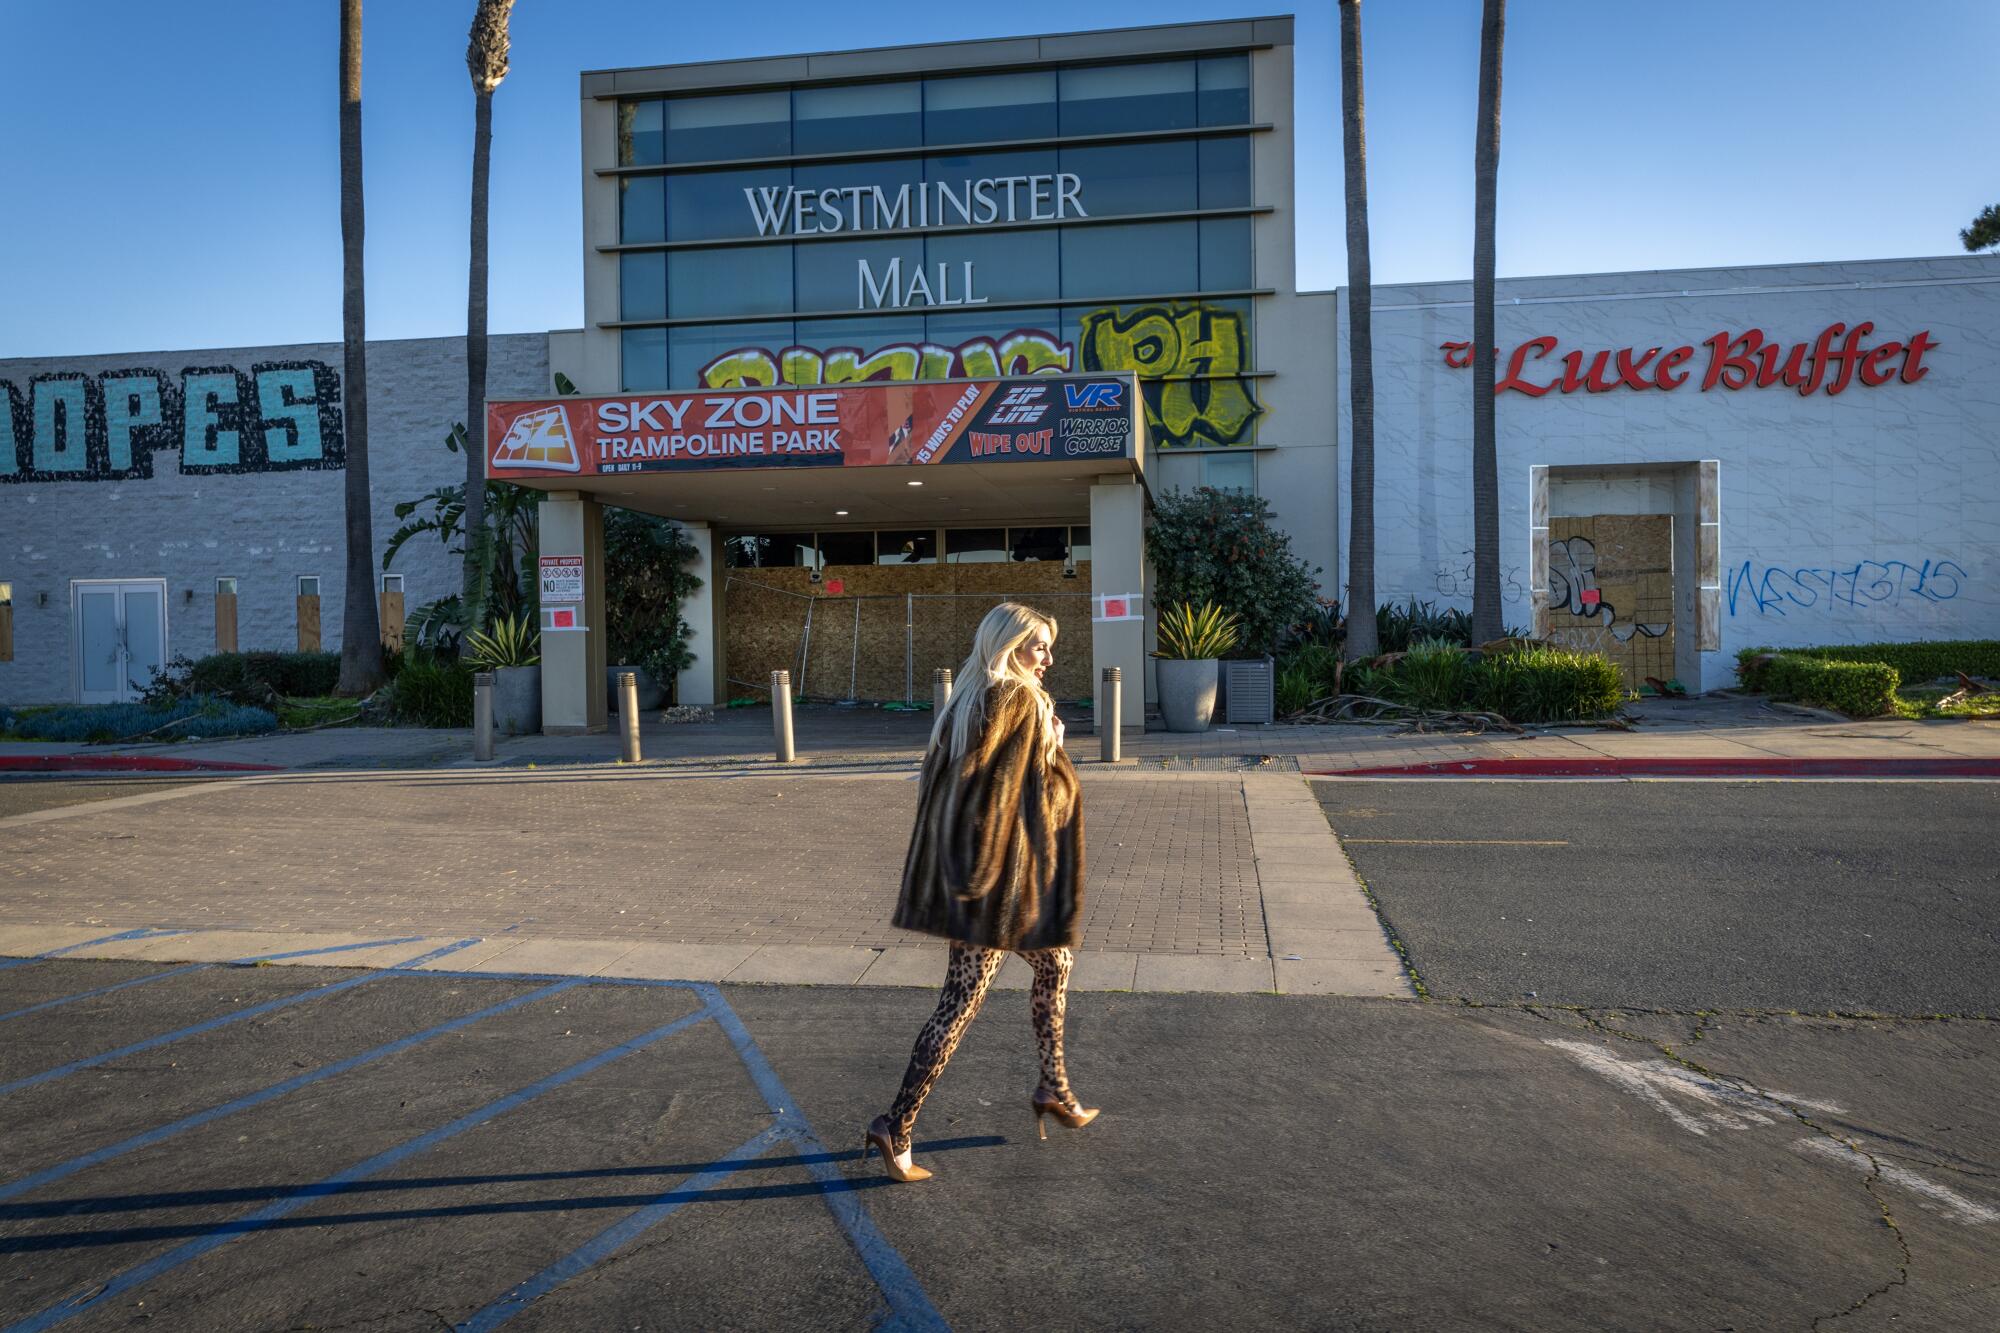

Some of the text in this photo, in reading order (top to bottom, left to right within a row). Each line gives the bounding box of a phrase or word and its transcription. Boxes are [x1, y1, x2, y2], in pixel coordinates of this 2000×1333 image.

[744, 172, 1089, 237] WESTMINSTER
[857, 256, 989, 310] MALL
[1493, 335, 1695, 398] Luxe
[1701, 321, 1941, 396] Buffet
[1000, 386, 1047, 405] ZIP
[1064, 382, 1123, 408] VR
[598, 392, 840, 434] SKY ZONE
[916, 383, 980, 464] 15 WAYS TO PLAY
[1060, 417, 1129, 438] WARRIOR
[597, 429, 841, 460] TRAMPOLINE PARK
[968, 428, 1054, 457] WIPE OUT
[1064, 435, 1123, 456] COURSE
[602, 464, 615, 472] OPEN
[617, 463, 631, 472] DAILY
[544, 580, 555, 592] NO
